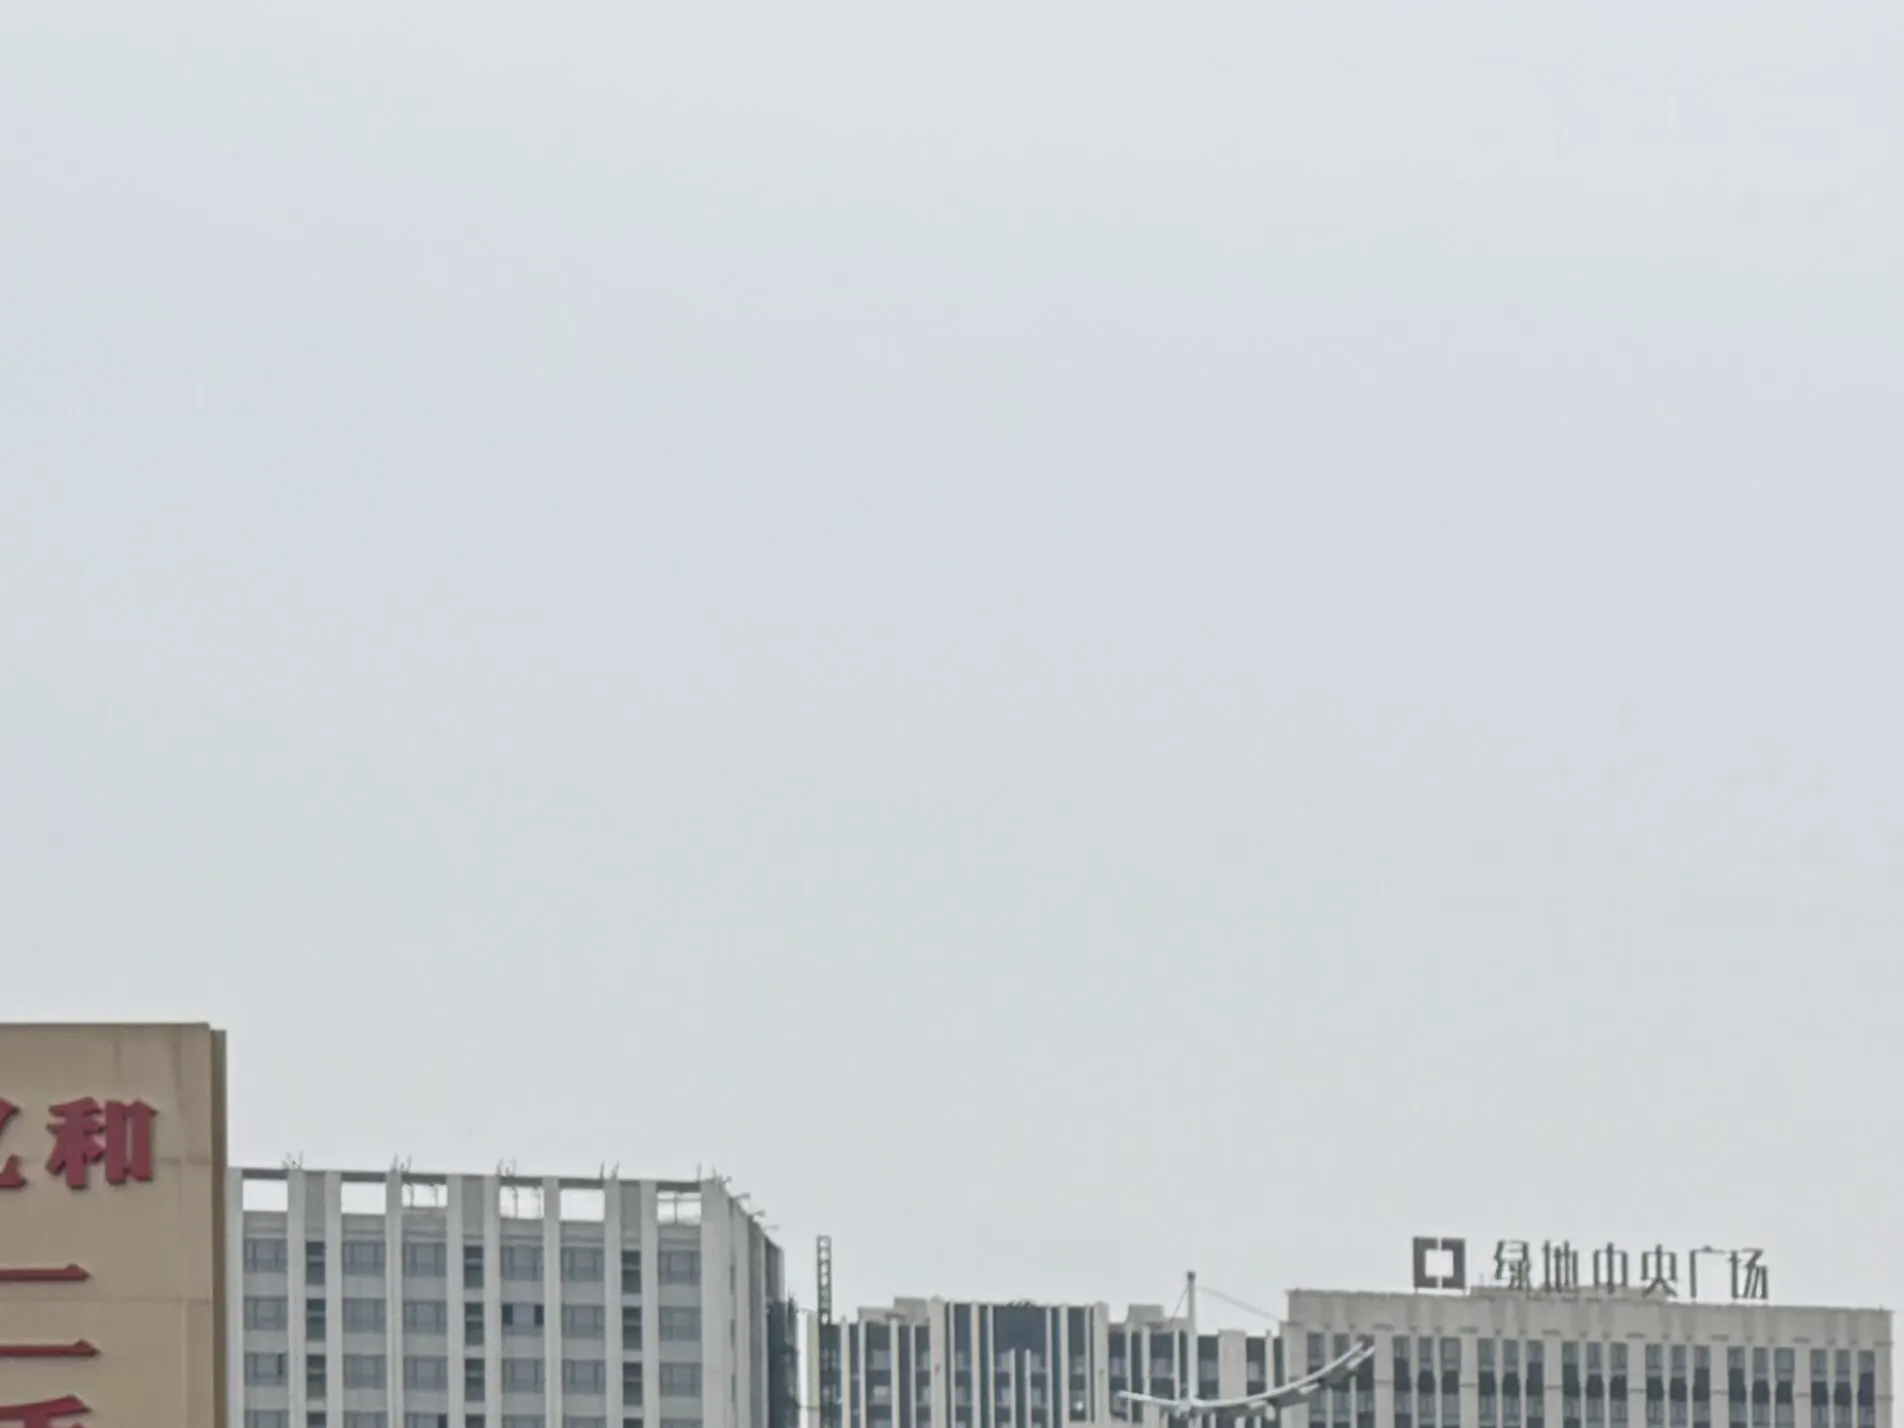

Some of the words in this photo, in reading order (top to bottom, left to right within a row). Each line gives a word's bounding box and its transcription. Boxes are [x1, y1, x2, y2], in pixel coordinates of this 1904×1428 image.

[0, 1097, 157, 1189] 和
[1494, 1239, 1768, 1299] 绿地中央广场
